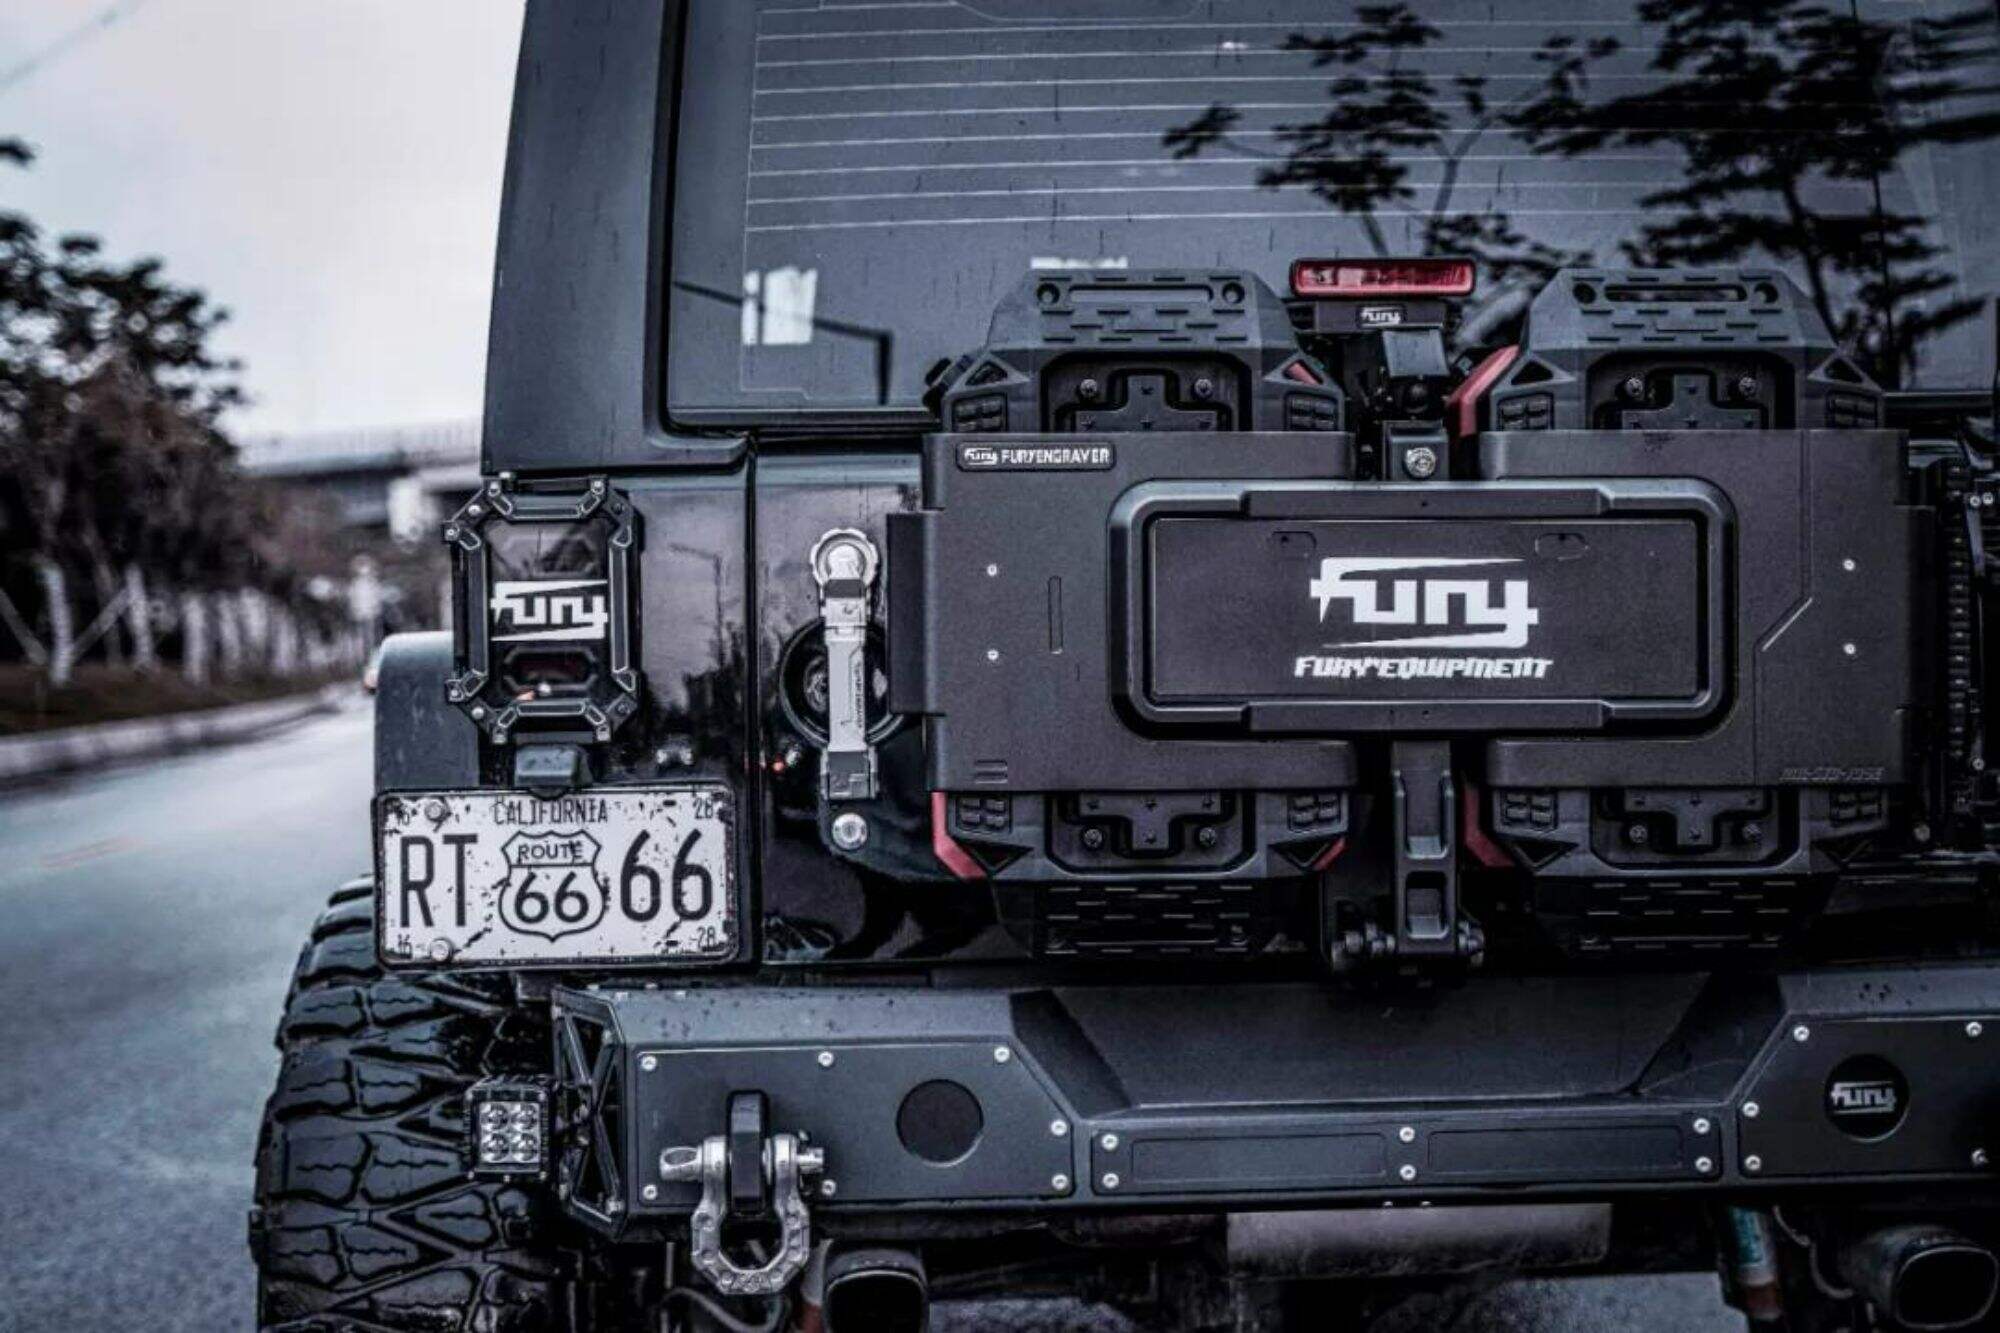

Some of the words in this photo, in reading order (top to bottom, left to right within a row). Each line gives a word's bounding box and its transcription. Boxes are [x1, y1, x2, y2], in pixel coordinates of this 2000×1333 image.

[493, 799, 608, 826] CALIFORNIA
[517, 842, 583, 863] ROUTE
[619, 828, 713, 922] 66
[400, 833, 479, 929] RT
[513, 870, 590, 924] 66
